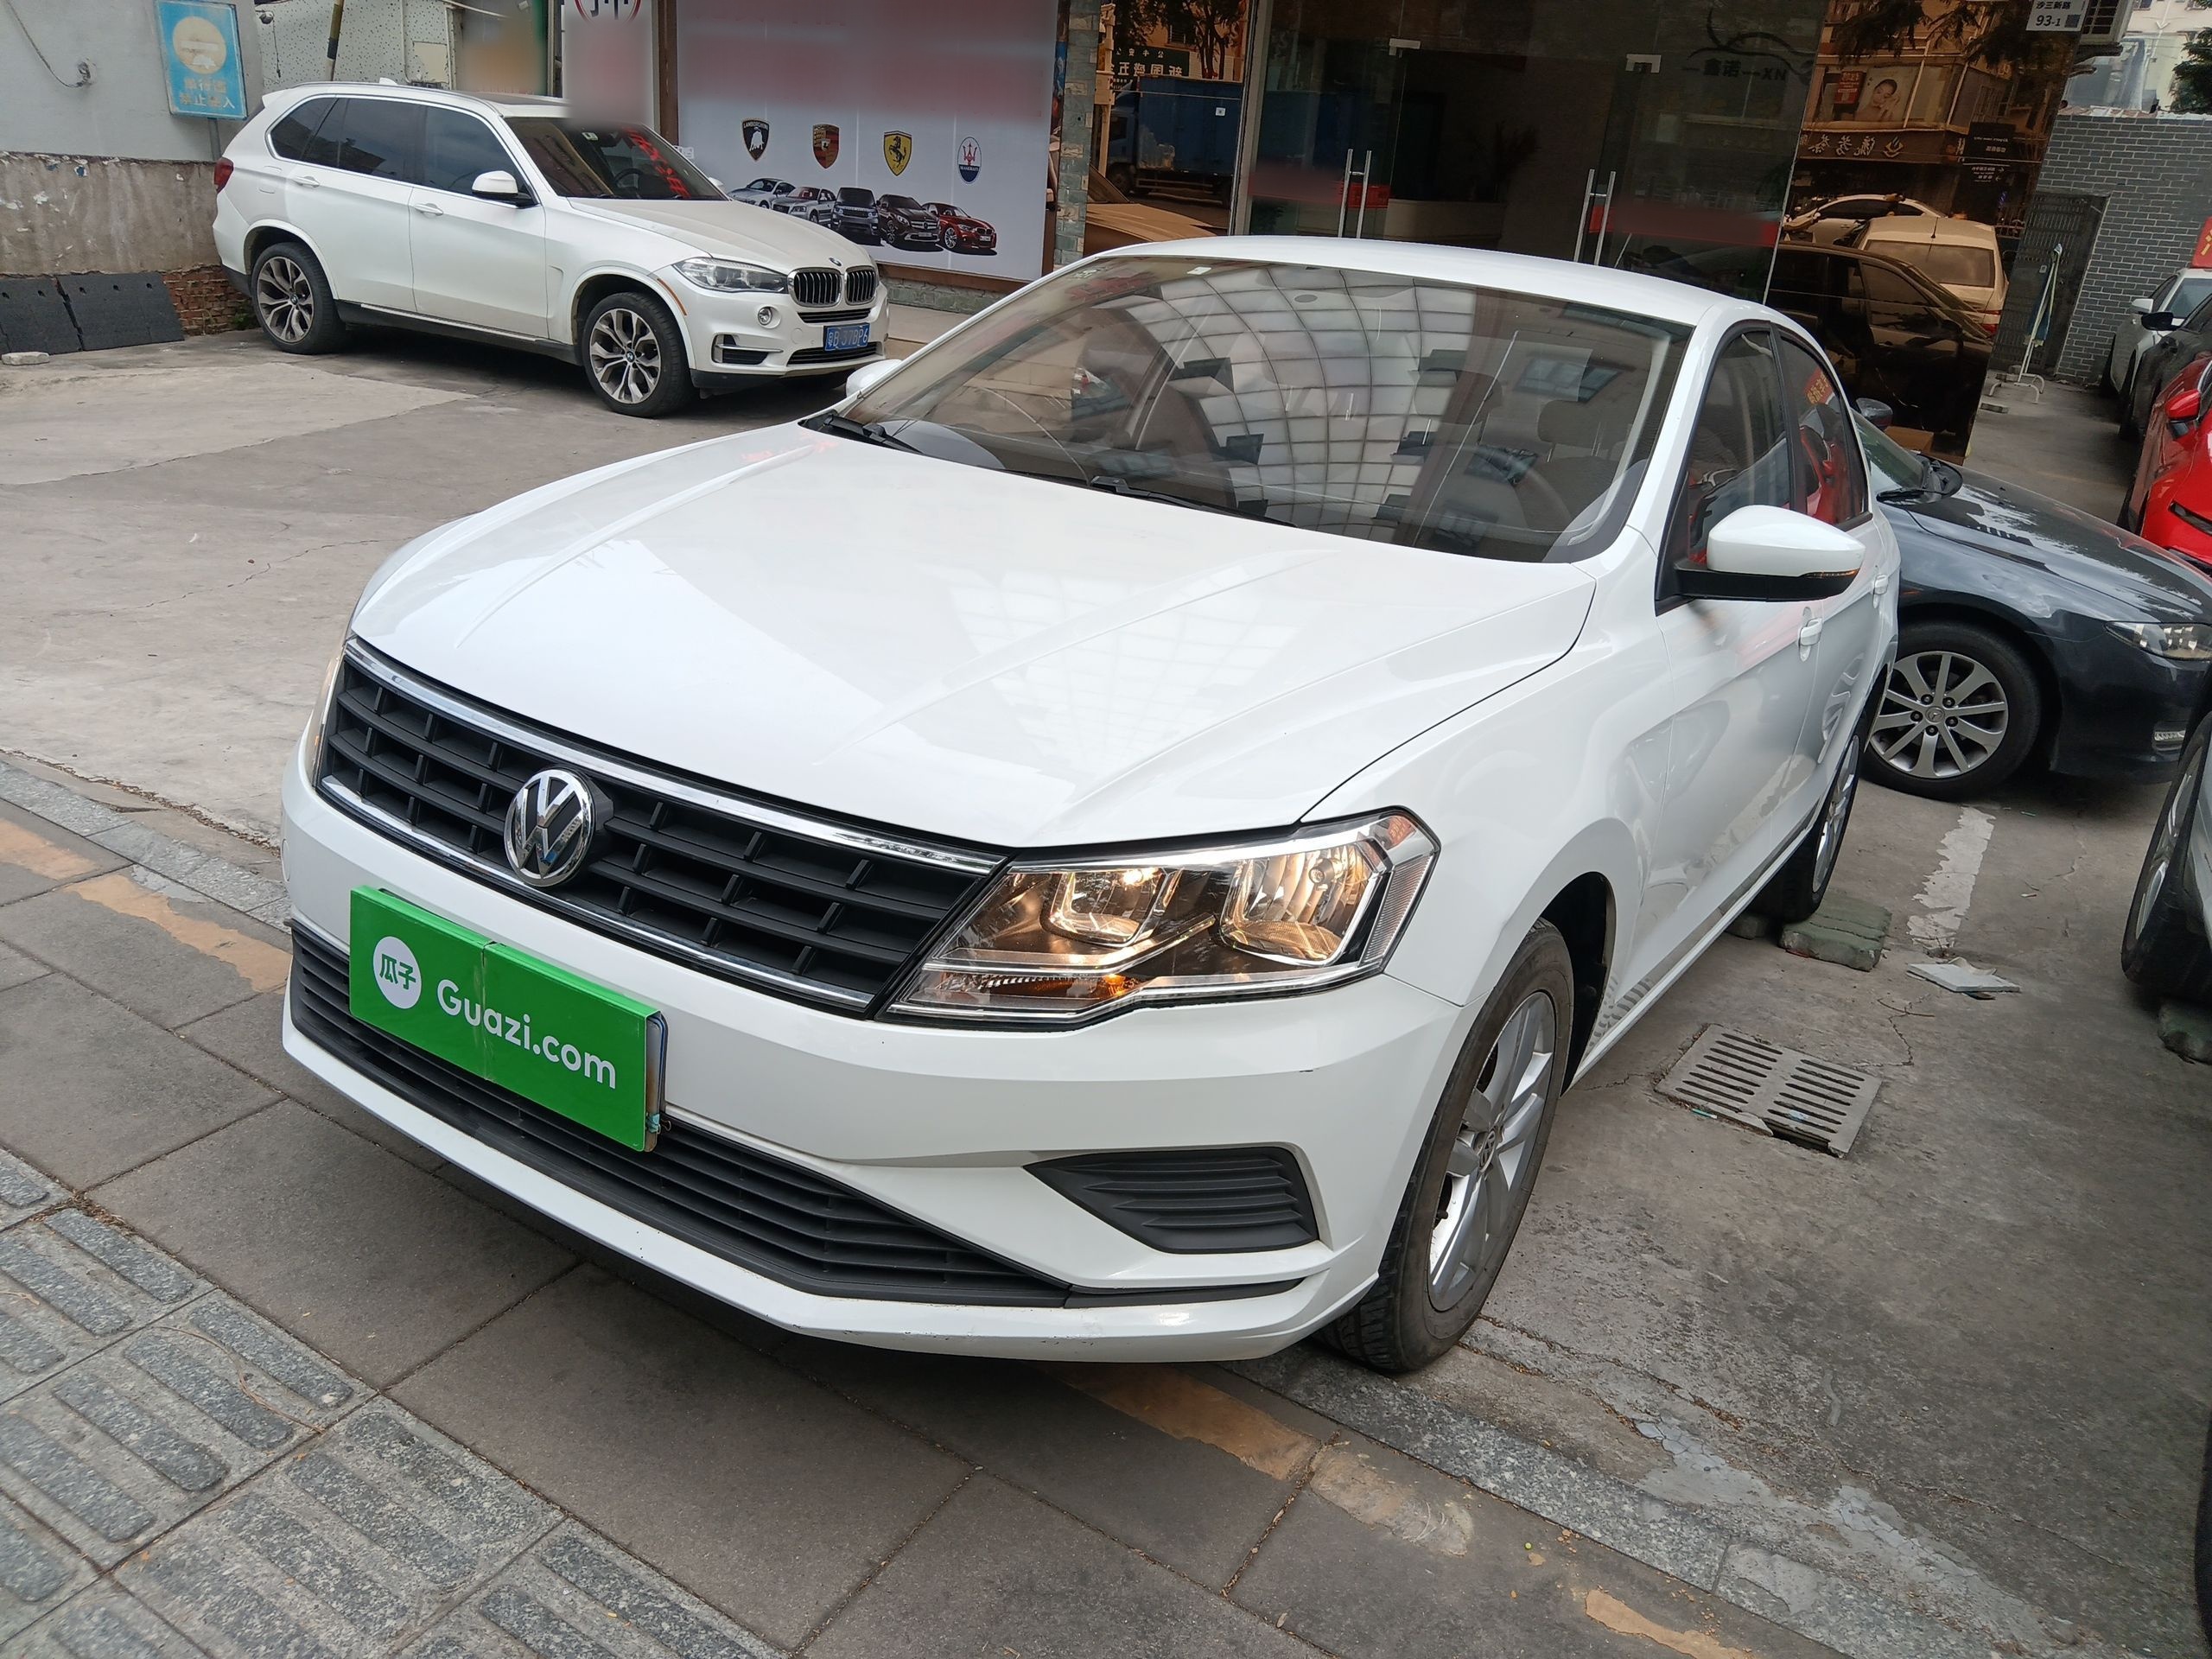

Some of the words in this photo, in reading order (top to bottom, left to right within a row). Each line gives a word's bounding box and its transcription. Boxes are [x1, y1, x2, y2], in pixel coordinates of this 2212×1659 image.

[2036, 15, 2061, 27] 93-1
[379, 953, 416, 990] 瓜子
[437, 979, 616, 1090] Guazi.com
